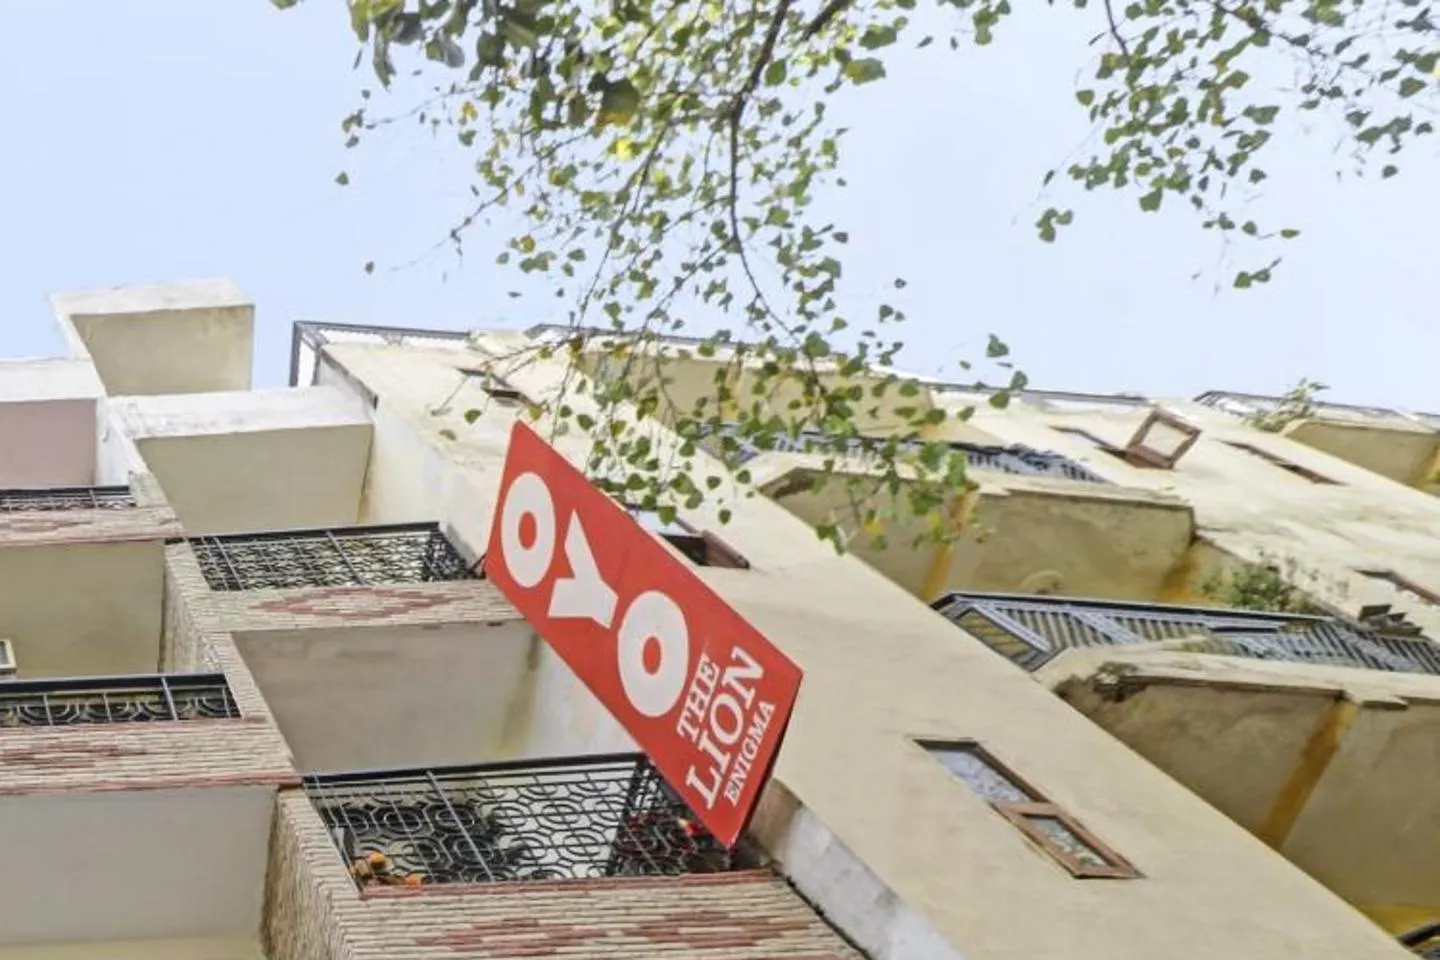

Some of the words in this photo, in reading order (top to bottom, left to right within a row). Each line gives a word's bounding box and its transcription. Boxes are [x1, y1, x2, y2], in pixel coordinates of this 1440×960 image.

[501, 472, 689, 717] OYO
[676, 652, 720, 743] THE
[686, 645, 765, 809] LION
[724, 699, 776, 807] ENIGMA
